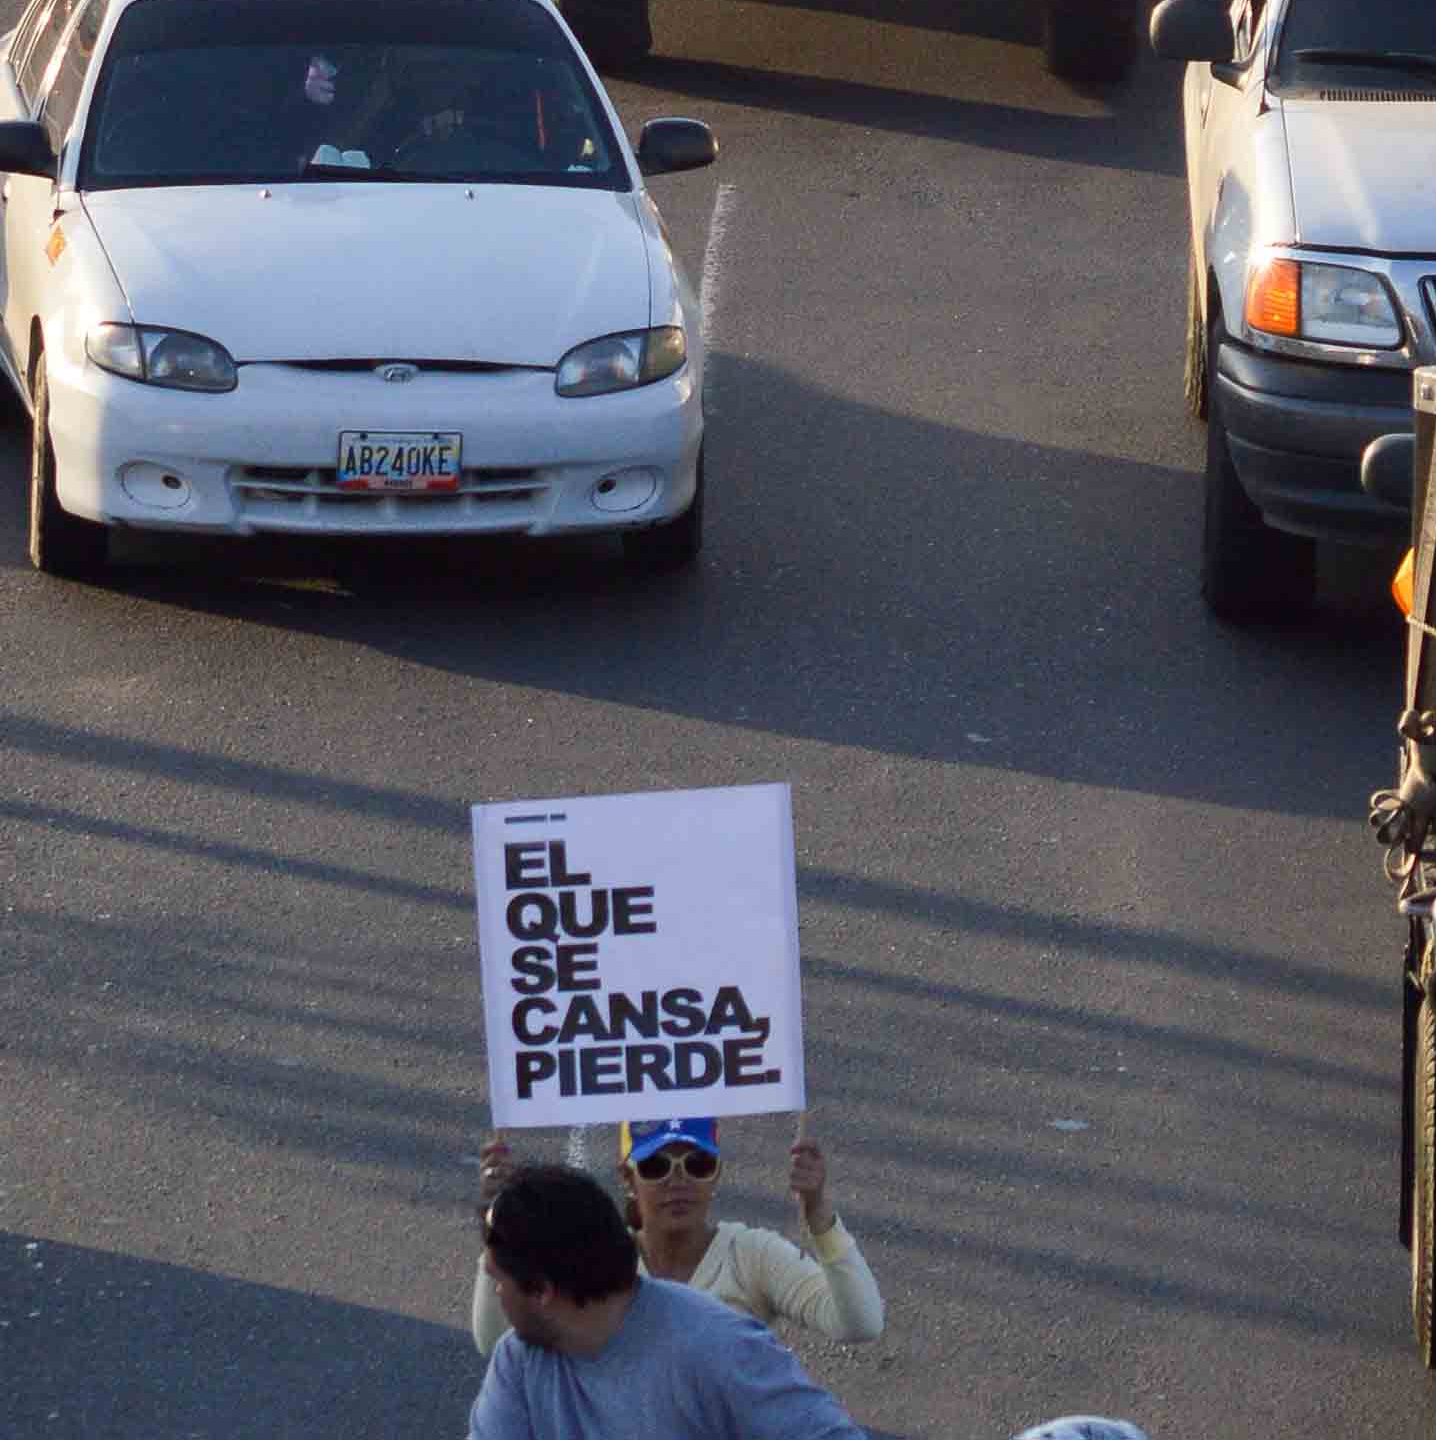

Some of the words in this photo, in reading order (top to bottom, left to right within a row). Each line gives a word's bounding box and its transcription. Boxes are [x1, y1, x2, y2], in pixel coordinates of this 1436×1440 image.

[345, 445, 452, 476] AB240KE
[504, 839, 592, 890] EL
[505, 885, 657, 944] QUE
[510, 943, 602, 995] SE
[511, 985, 771, 1046] CANSA,
[515, 1038, 782, 1100] PIERDE.
